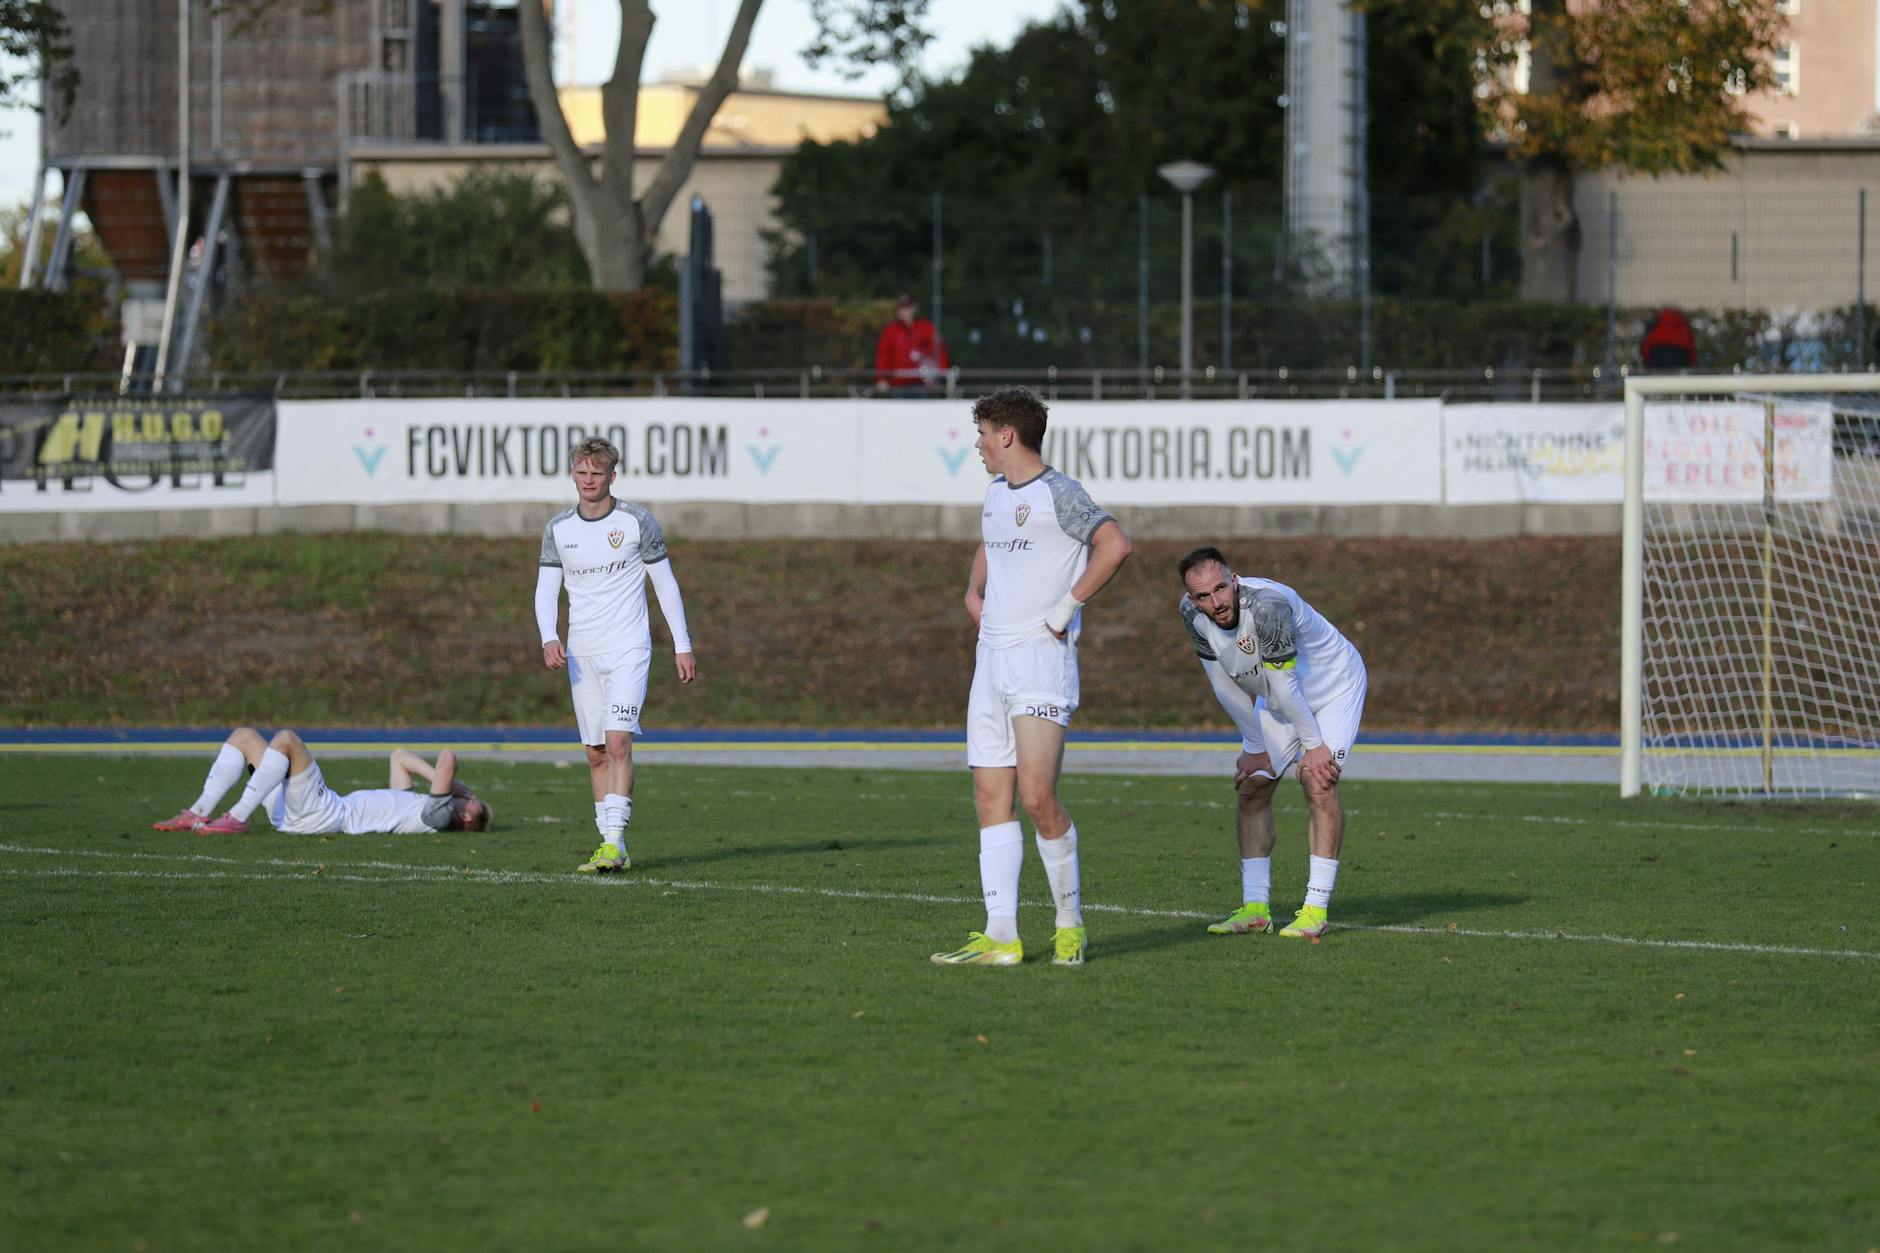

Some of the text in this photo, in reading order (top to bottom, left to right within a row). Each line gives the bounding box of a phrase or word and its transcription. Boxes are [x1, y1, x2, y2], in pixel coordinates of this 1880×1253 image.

[407, 424, 730, 478] FCVIKTORA.COM
[1045, 427, 1312, 480] IKTORIA.COM
[612, 704, 638, 716] DWB
[1026, 706, 1059, 717] DWB
